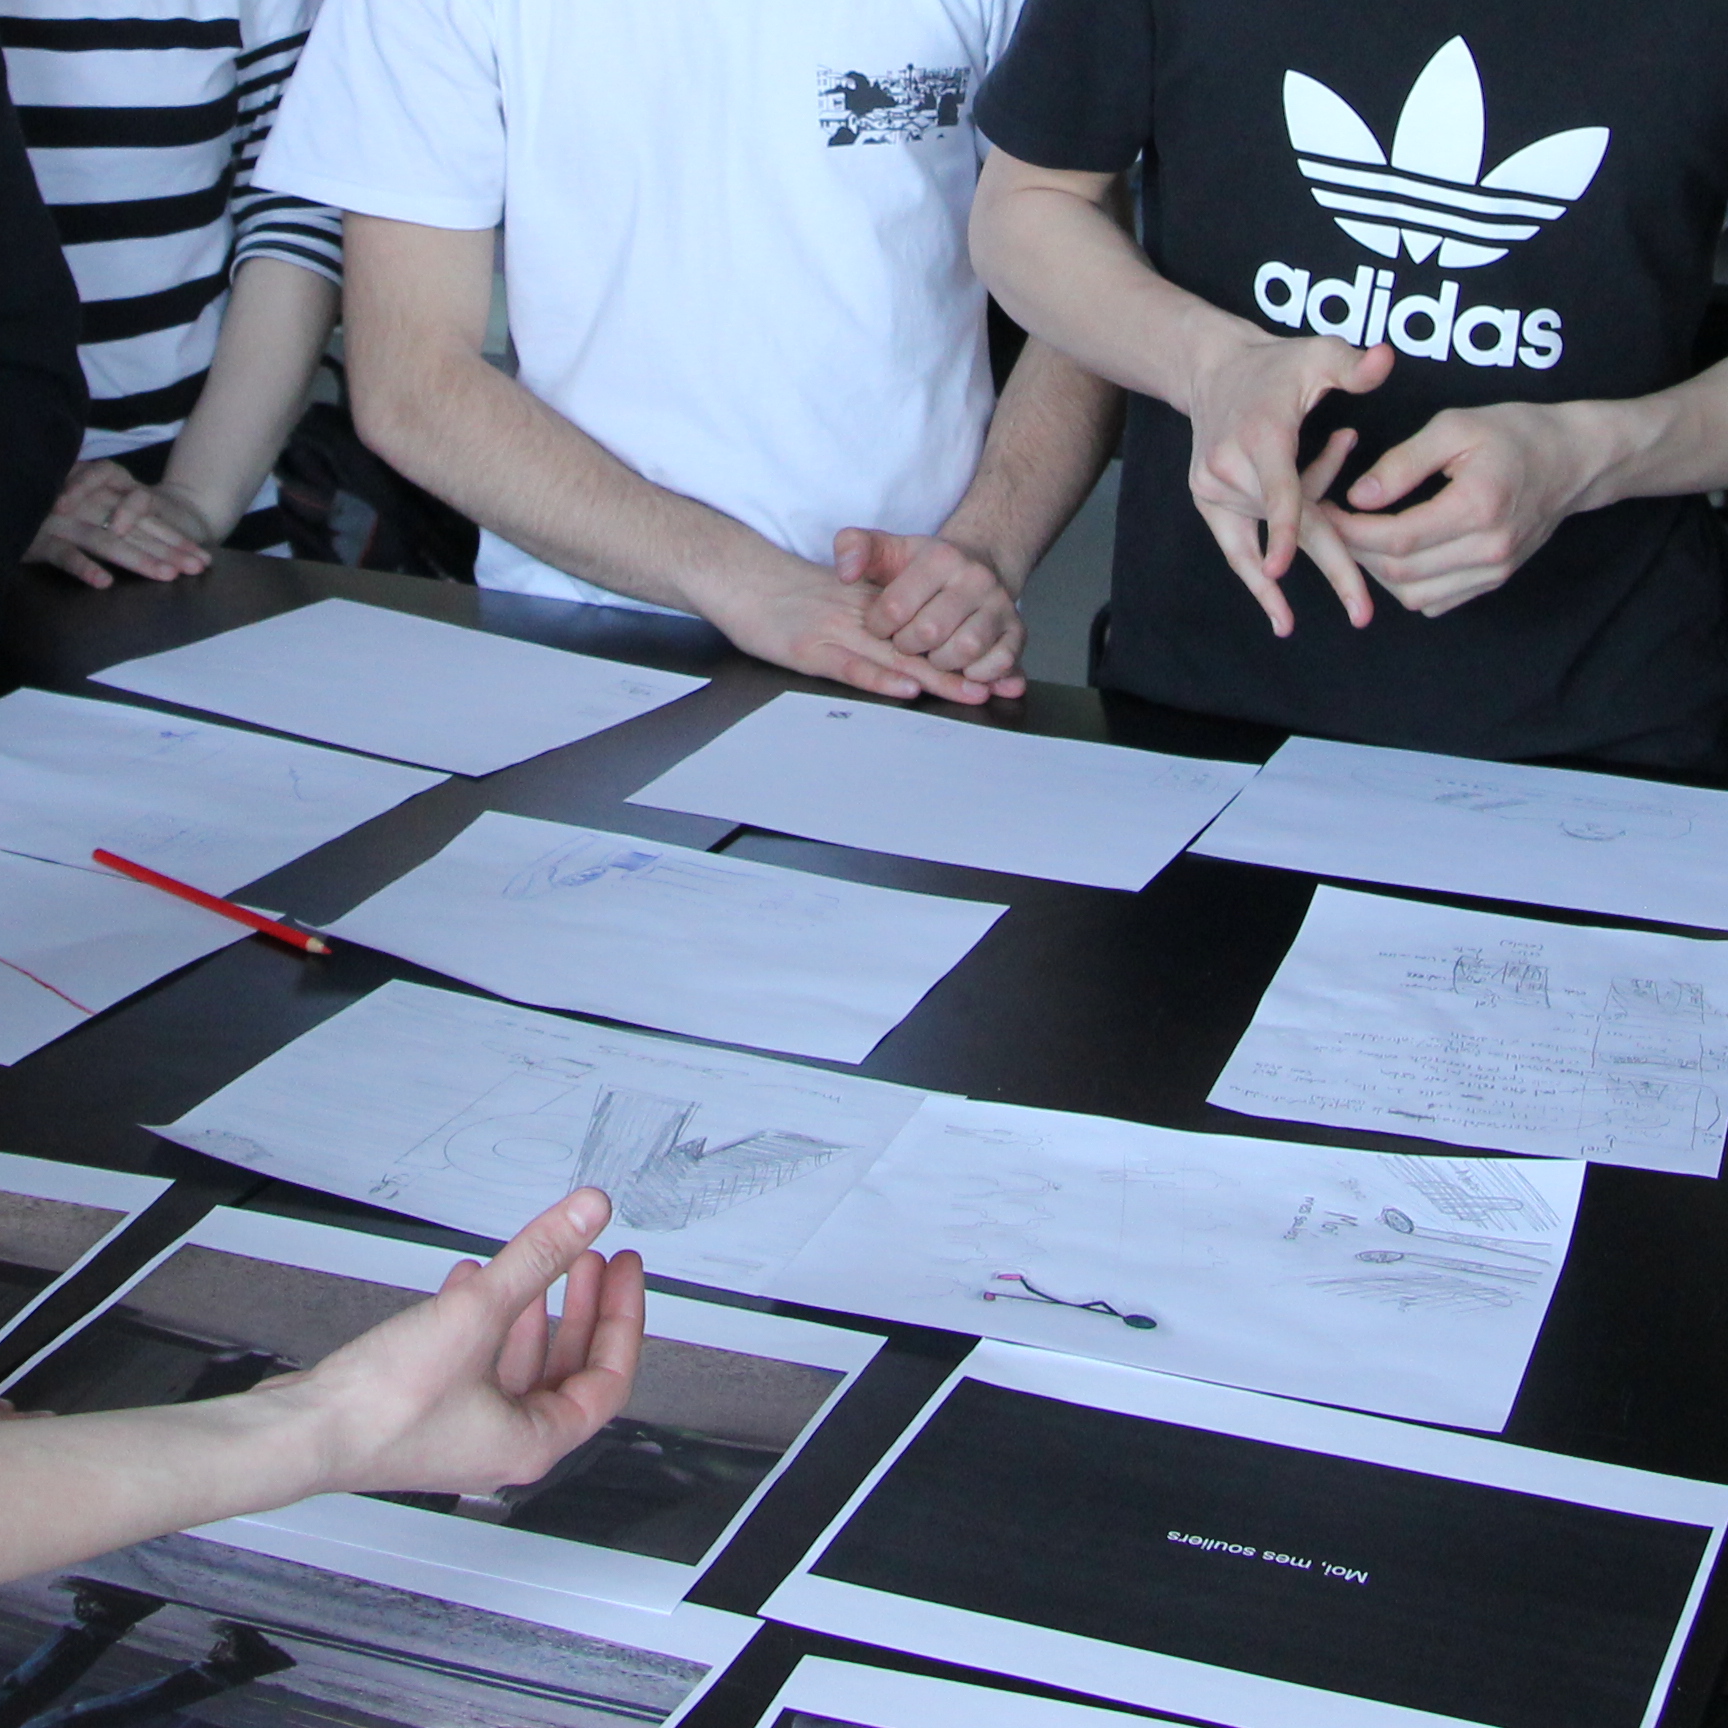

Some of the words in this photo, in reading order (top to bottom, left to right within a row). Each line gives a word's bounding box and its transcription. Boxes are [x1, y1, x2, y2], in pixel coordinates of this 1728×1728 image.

[1254, 260, 1564, 370] adidas
[1166, 1530, 1257, 1558] souliers
[1261, 1550, 1313, 1570] mes
[1320, 1560, 1369, 1585] Moi,
